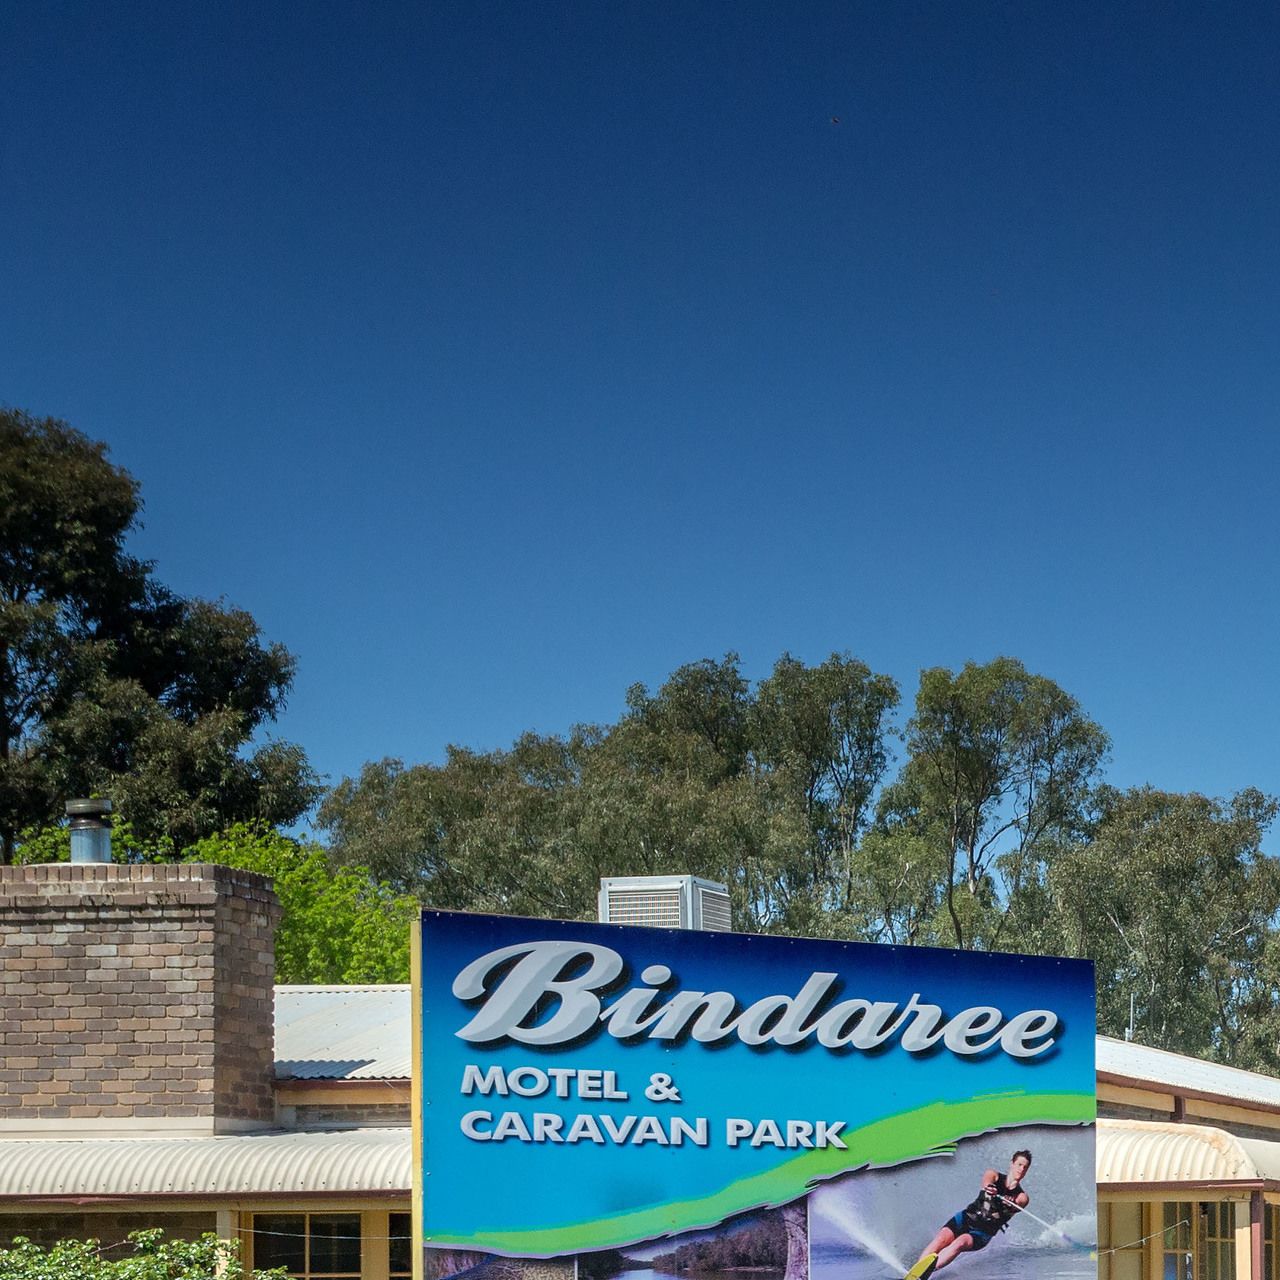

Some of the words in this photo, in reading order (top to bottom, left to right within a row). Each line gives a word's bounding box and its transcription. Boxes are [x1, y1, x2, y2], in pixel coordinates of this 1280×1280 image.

[451, 940, 1058, 1057] Bindaree
[460, 1065, 628, 1100] MOTEL
[644, 1072, 681, 1101] &
[460, 1110, 708, 1147] CARAVAN
[726, 1118, 848, 1149] PARK
